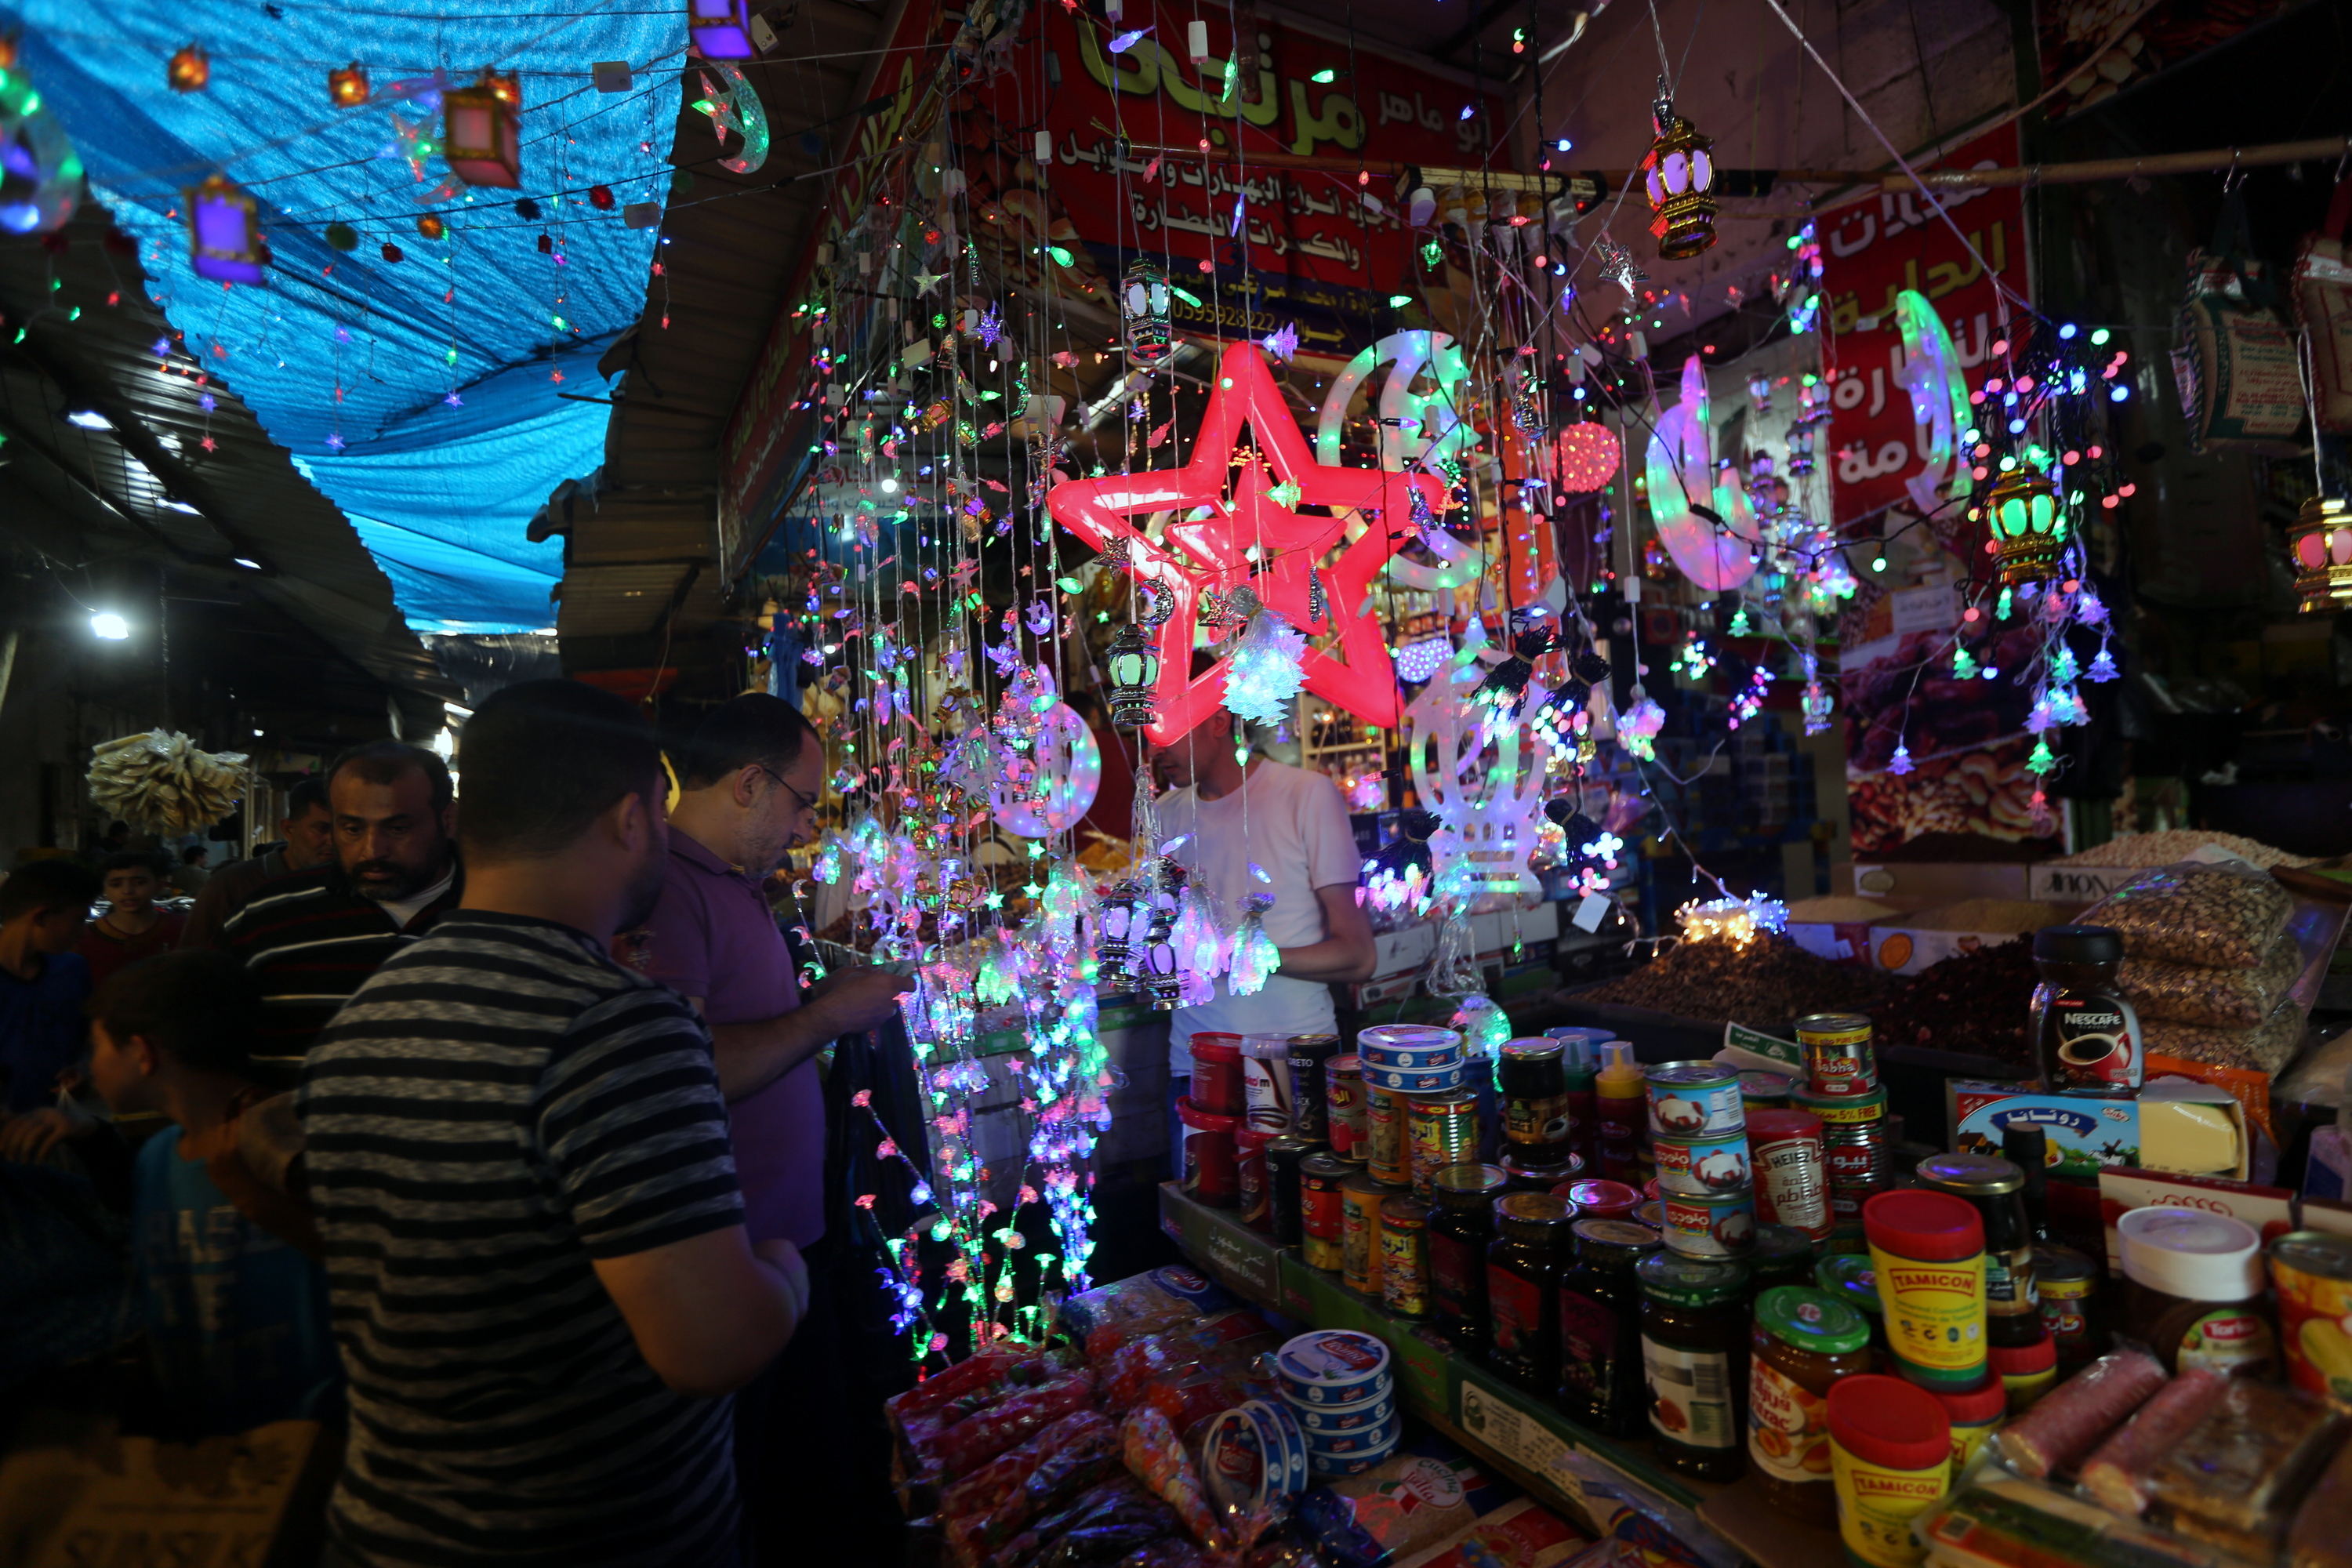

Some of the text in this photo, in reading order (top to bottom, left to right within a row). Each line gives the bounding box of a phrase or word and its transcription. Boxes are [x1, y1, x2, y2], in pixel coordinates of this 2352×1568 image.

[1377, 89, 1445, 133] ماهر
[1894, 1276, 1973, 1290] TAMICON
[1417, 1458, 1459, 1494] Cucina
[1857, 1478, 1940, 1495] TAMICON
